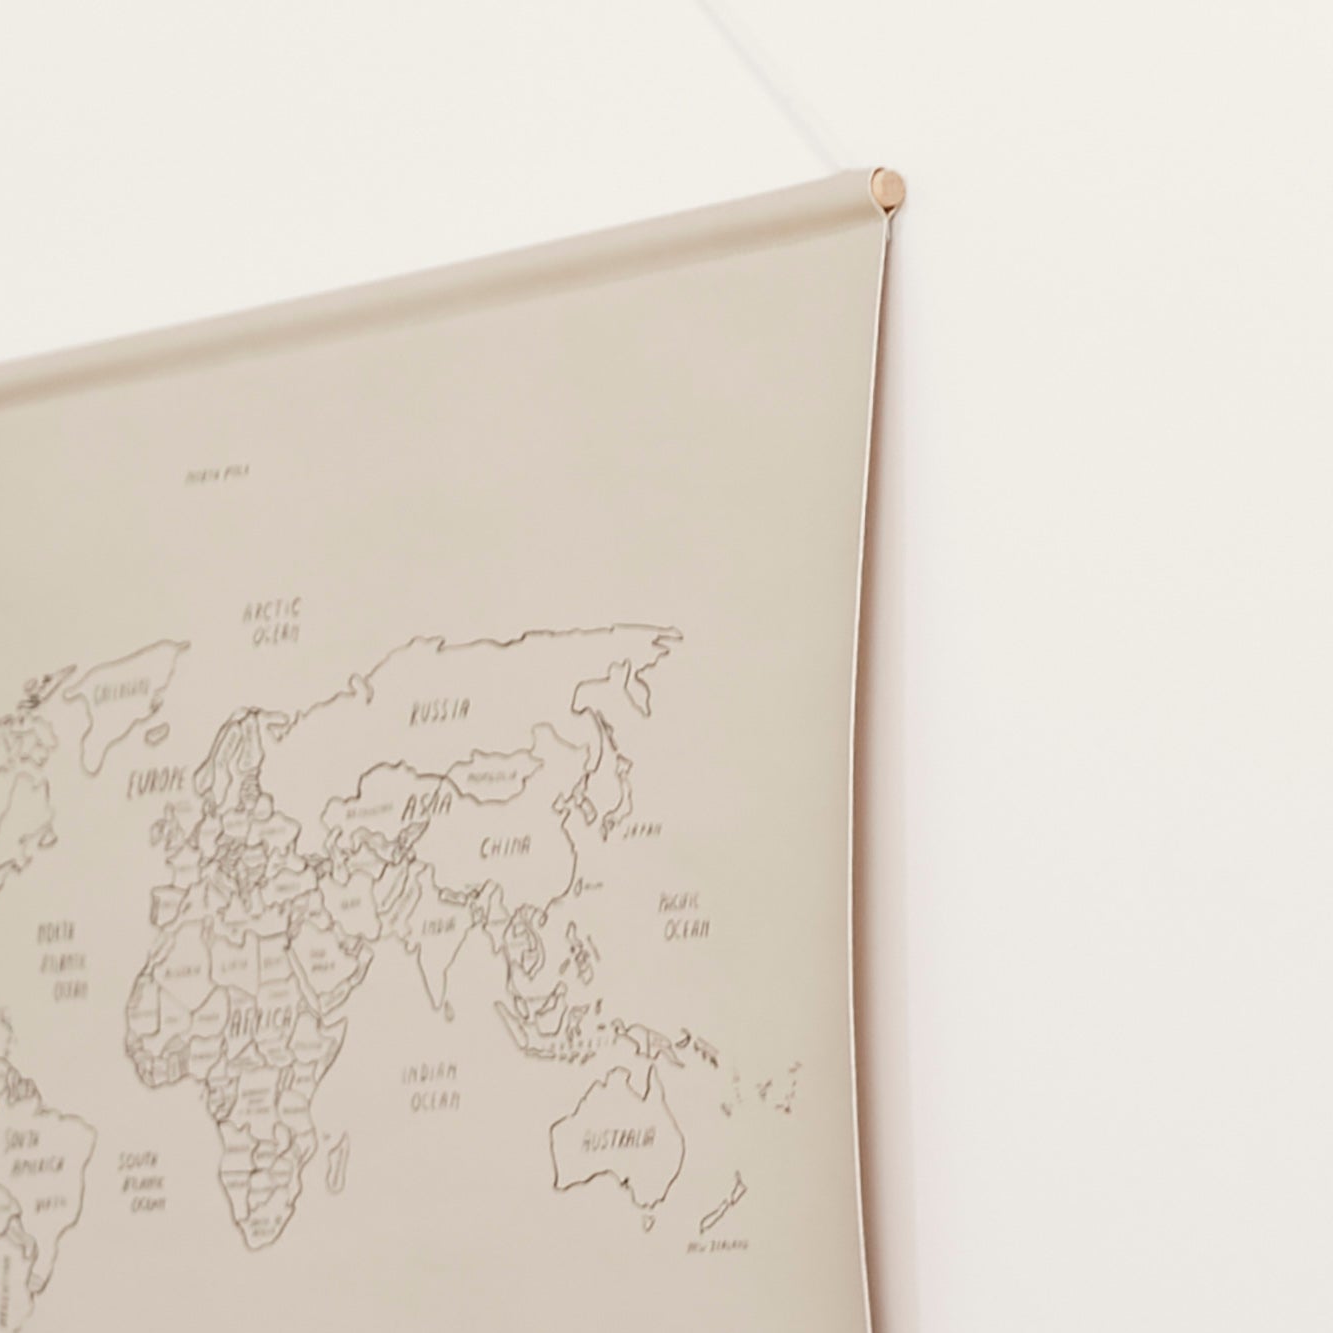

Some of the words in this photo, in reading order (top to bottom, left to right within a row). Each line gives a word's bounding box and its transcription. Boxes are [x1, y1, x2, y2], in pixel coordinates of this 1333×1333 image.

[242, 596, 302, 623] ARCTIC
[409, 697, 471, 727] RUSSIA
[127, 766, 187, 800] EUROPE
[400, 792, 453, 821] ASIA
[479, 835, 532, 860] CHINA
[664, 919, 710, 942] OCEAN
[401, 1061, 457, 1085] INDIAN
[411, 1090, 460, 1113] OCEAN
[581, 1125, 656, 1152] AUSTRALIA
